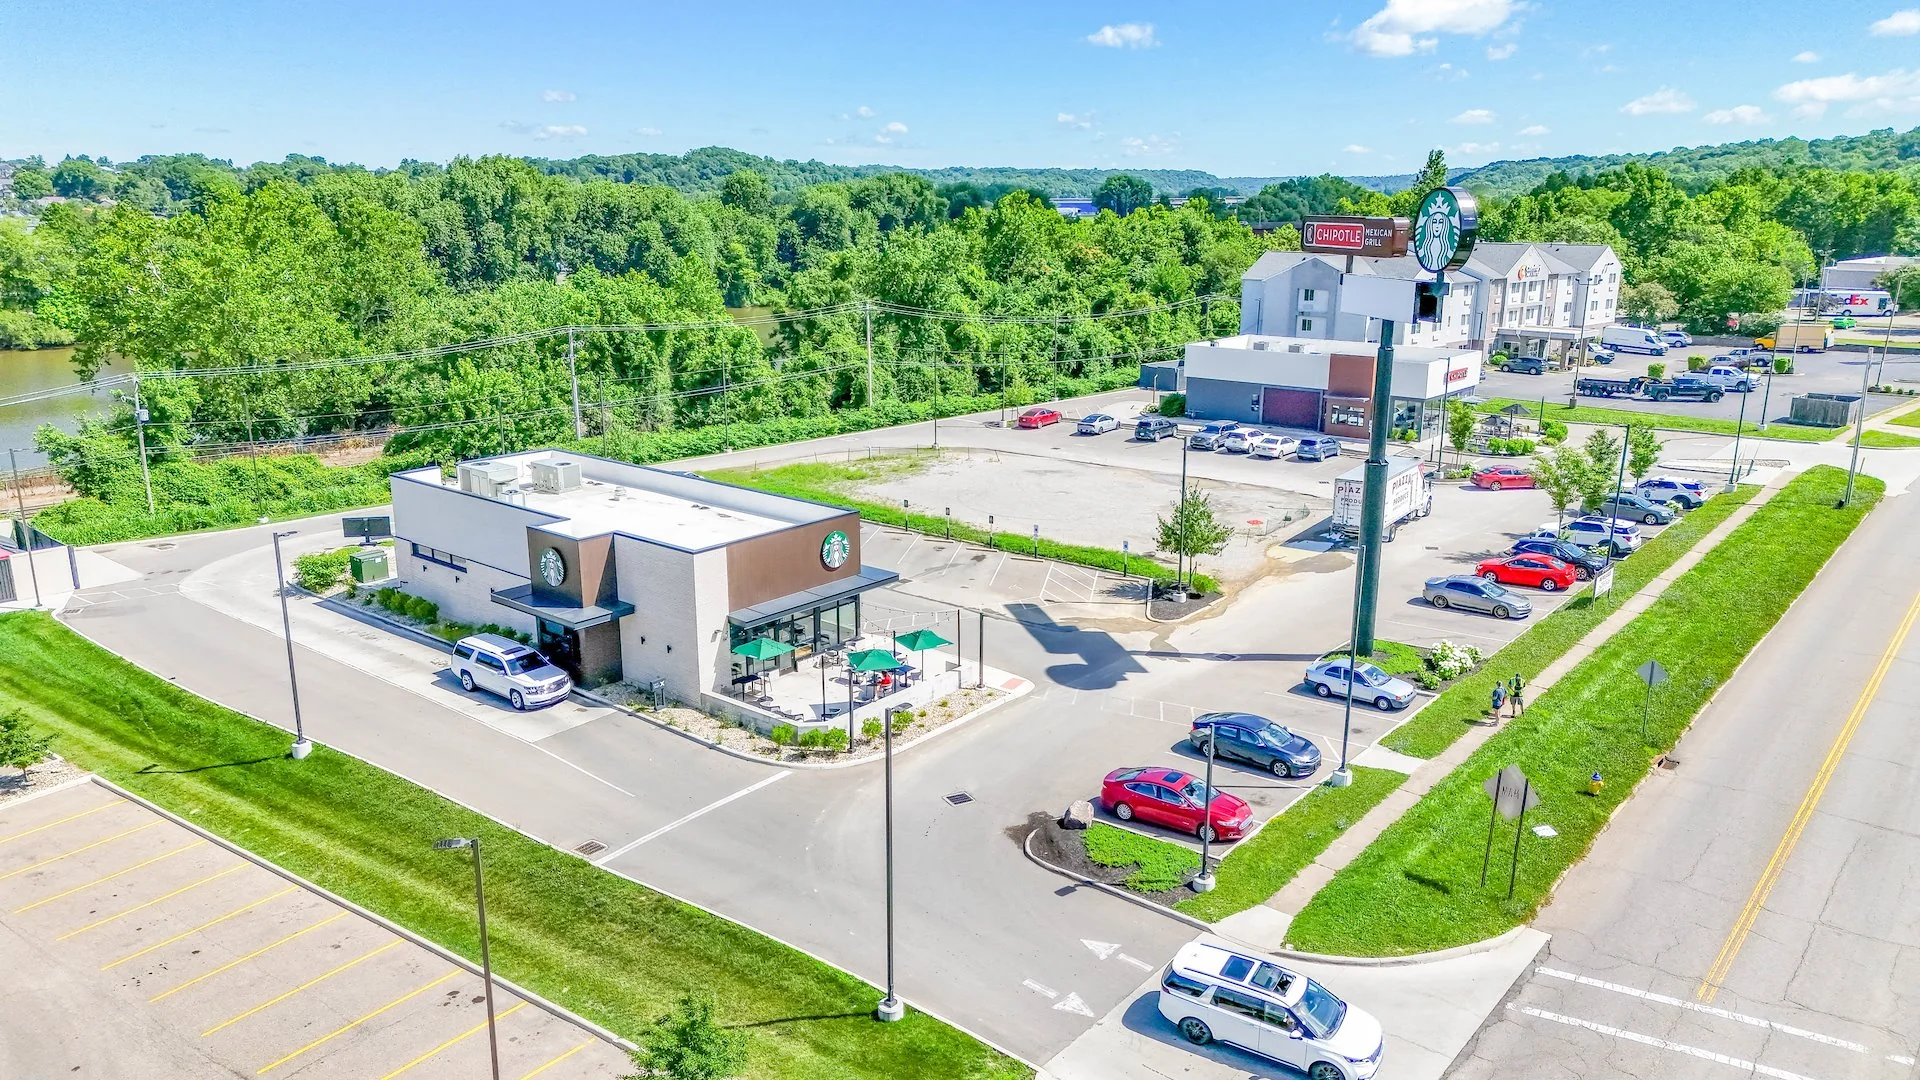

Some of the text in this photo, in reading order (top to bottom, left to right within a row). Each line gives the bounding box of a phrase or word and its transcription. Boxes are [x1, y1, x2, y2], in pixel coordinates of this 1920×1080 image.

[1316, 228, 1361, 243] CHIPOTLE
[1365, 228, 1393, 237] MEXICAN
[1365, 238, 1382, 247] GRILL
[1337, 486, 1361, 494] PIAZ
